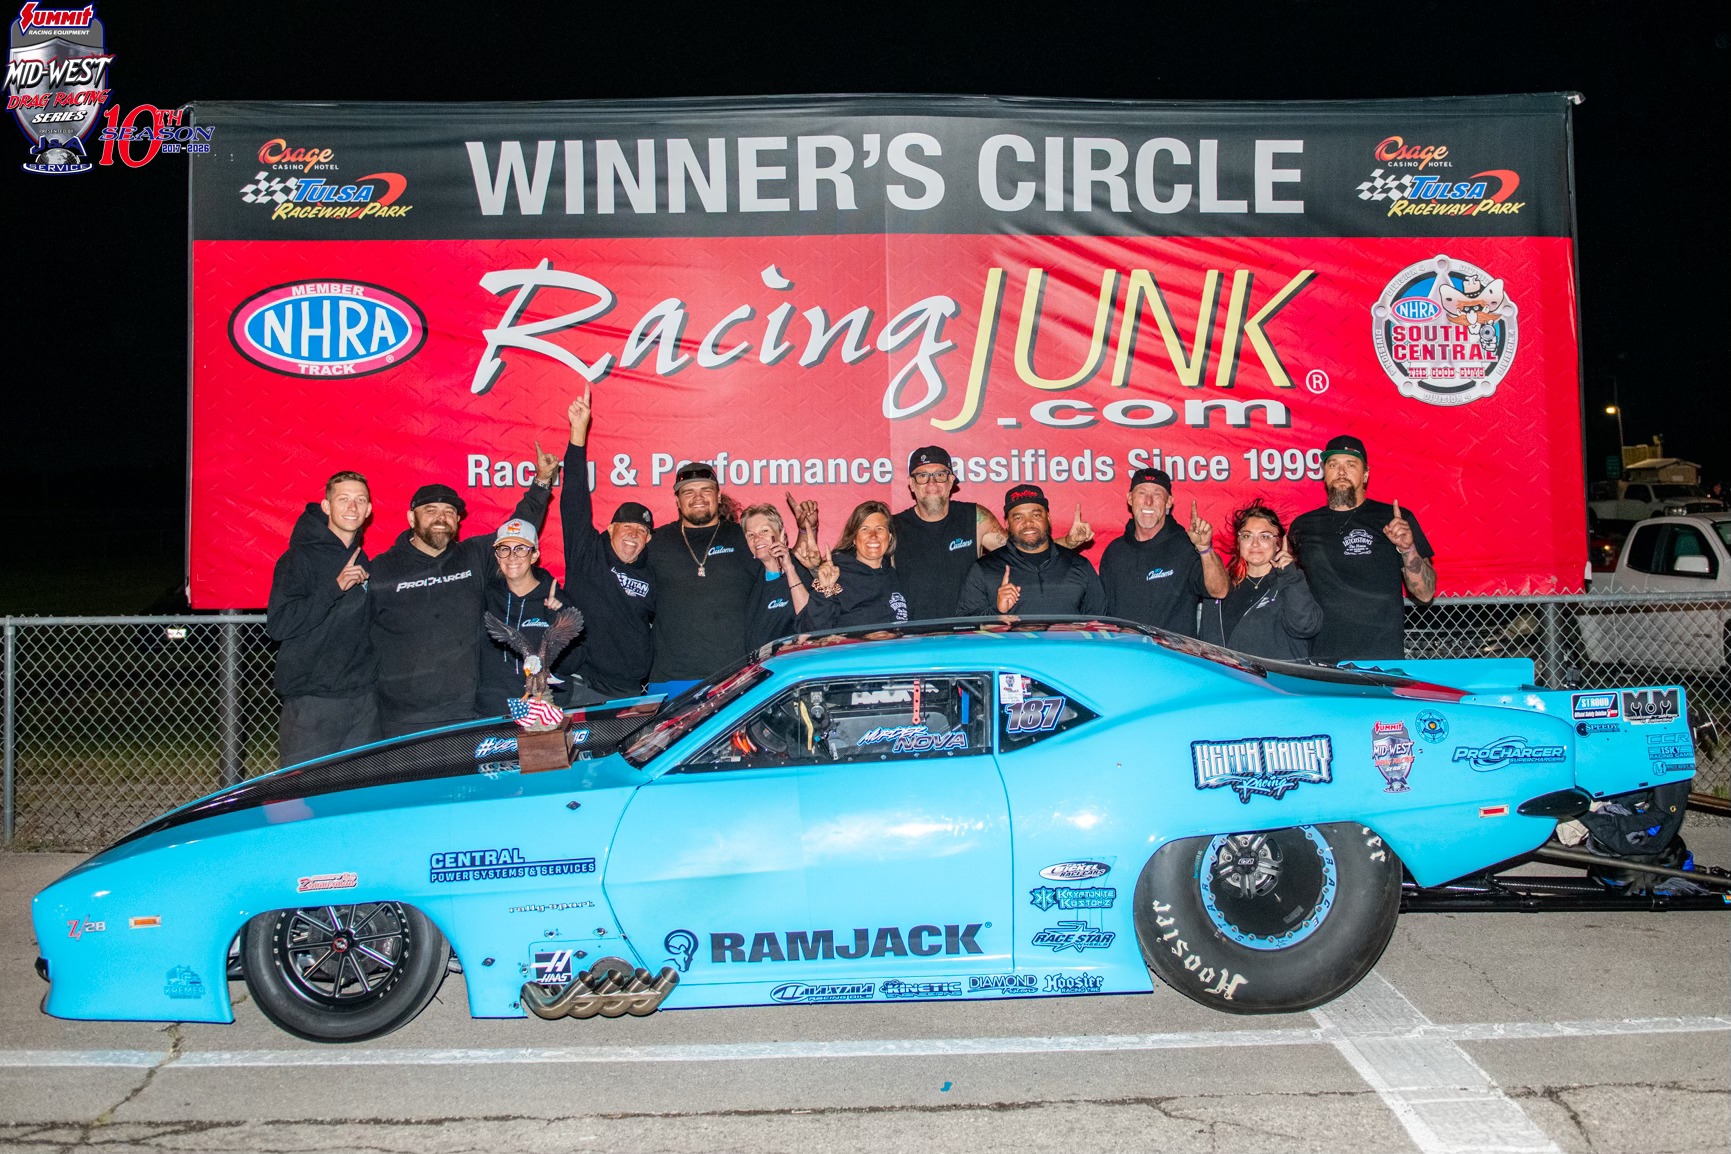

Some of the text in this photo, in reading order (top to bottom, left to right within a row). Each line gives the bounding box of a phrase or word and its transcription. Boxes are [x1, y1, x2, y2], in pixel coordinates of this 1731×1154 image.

[258, 138, 334, 173] Osage
[1374, 135, 1448, 170] Osage
[465, 132, 1304, 216] WINNER'S CIRCLE
[294, 177, 374, 202] TULSA
[1408, 175, 1487, 199] TULSA
[272, 202, 413, 220] RACEWAY PARK
[1387, 199, 1525, 217] RACEWAY PARK
[291, 283, 365, 296] MEMBER
[1400, 301, 1436, 318] NHRA
[264, 299, 397, 359] NHRA
[1391, 325, 1469, 342] SOUTH
[1392, 343, 1499, 362] CENTRAL
[298, 363, 356, 375] TRACK
[1408, 367, 1485, 378] THE GOOD GUYS
[997, 399, 1290, 428] .com
[610, 453, 638, 487] &
[1243, 448, 1325, 481] 1999
[1581, 698, 1610, 708] STROUD
[1005, 696, 1066, 733] 187
[857, 726, 928, 746] MURDER
[892, 732, 968, 753] NOVA
[1646, 732, 1690, 744] CCR
[1372, 741, 1414, 759] MID-WEST
[1660, 746, 1680, 755] ISKY
[430, 848, 525, 869] CENTRAL
[431, 863, 595, 883] POWER SYSTEMS & SERVICES
[1057, 889, 1114, 899] KRYPTONITE
[710, 922, 987, 963] RAMJACK
[1035, 934, 1113, 943] RACE STAR
[542, 973, 568, 982] HAAS
[970, 976, 1038, 988] DIAMOND
[1043, 972, 1104, 992] Hoosier
[887, 983, 961, 993] KINETIC
